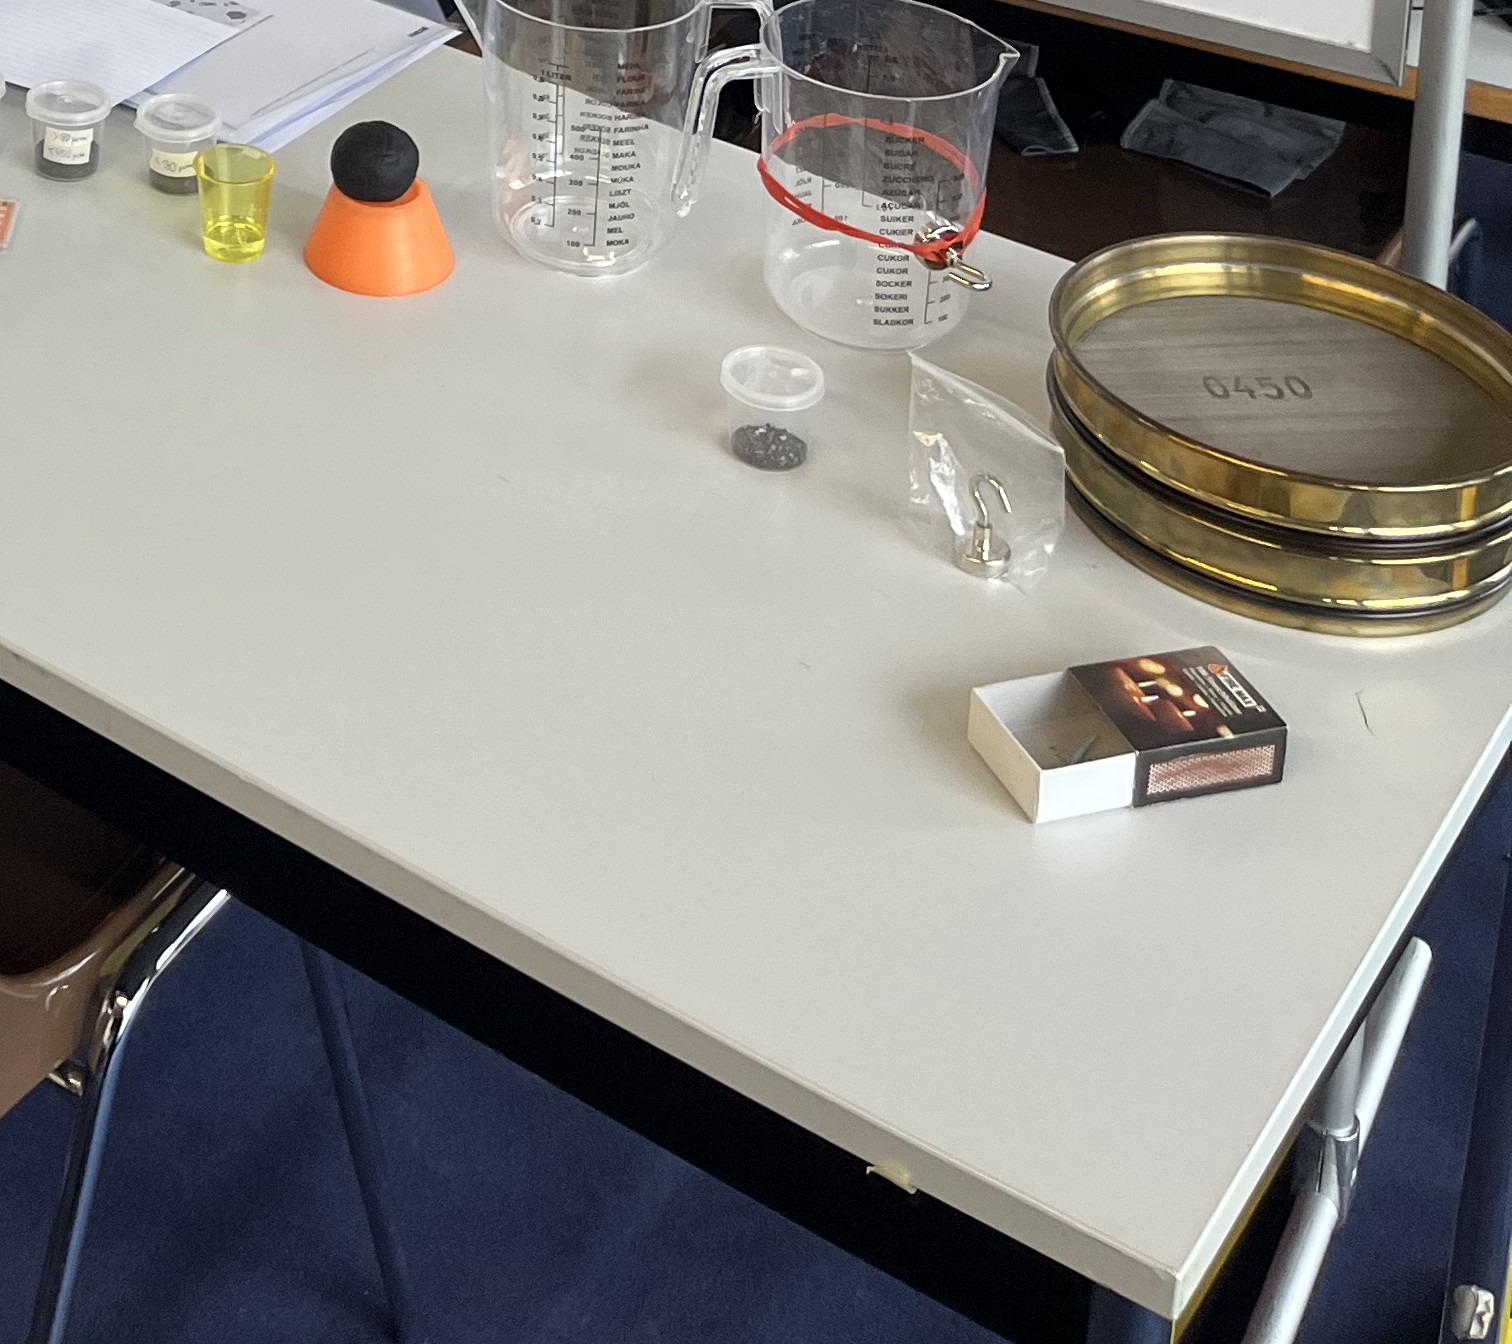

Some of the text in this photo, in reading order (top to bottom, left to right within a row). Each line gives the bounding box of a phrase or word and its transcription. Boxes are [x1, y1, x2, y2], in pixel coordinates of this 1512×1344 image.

[877, 254, 910, 262] CUKOR
[876, 267, 909, 275] CUKOR
[875, 279, 913, 288] SOCKER
[1202, 375, 1313, 400] 0450
